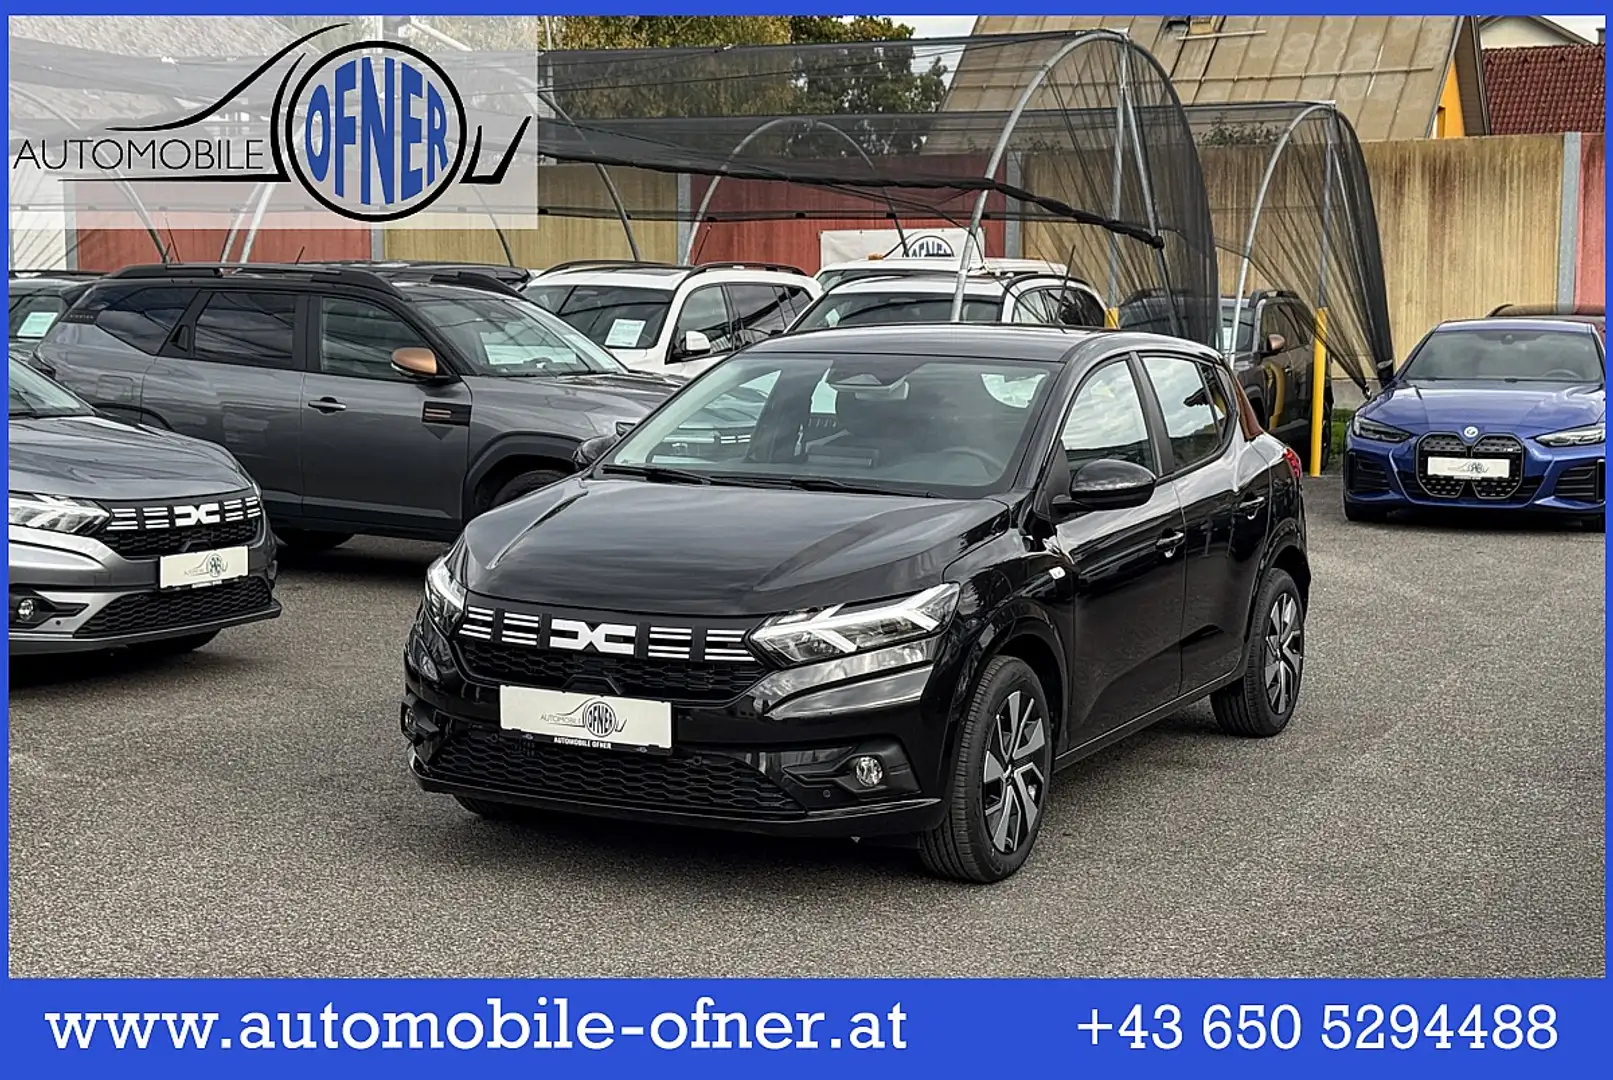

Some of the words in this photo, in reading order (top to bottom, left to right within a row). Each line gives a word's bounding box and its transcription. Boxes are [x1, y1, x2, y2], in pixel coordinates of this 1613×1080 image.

[539, 714, 581, 725] AUTOMOBILE
[587, 704, 613, 735] OFNER
[553, 736, 591, 748] AUTOMOBILE
[591, 741, 612, 750] OFNER
